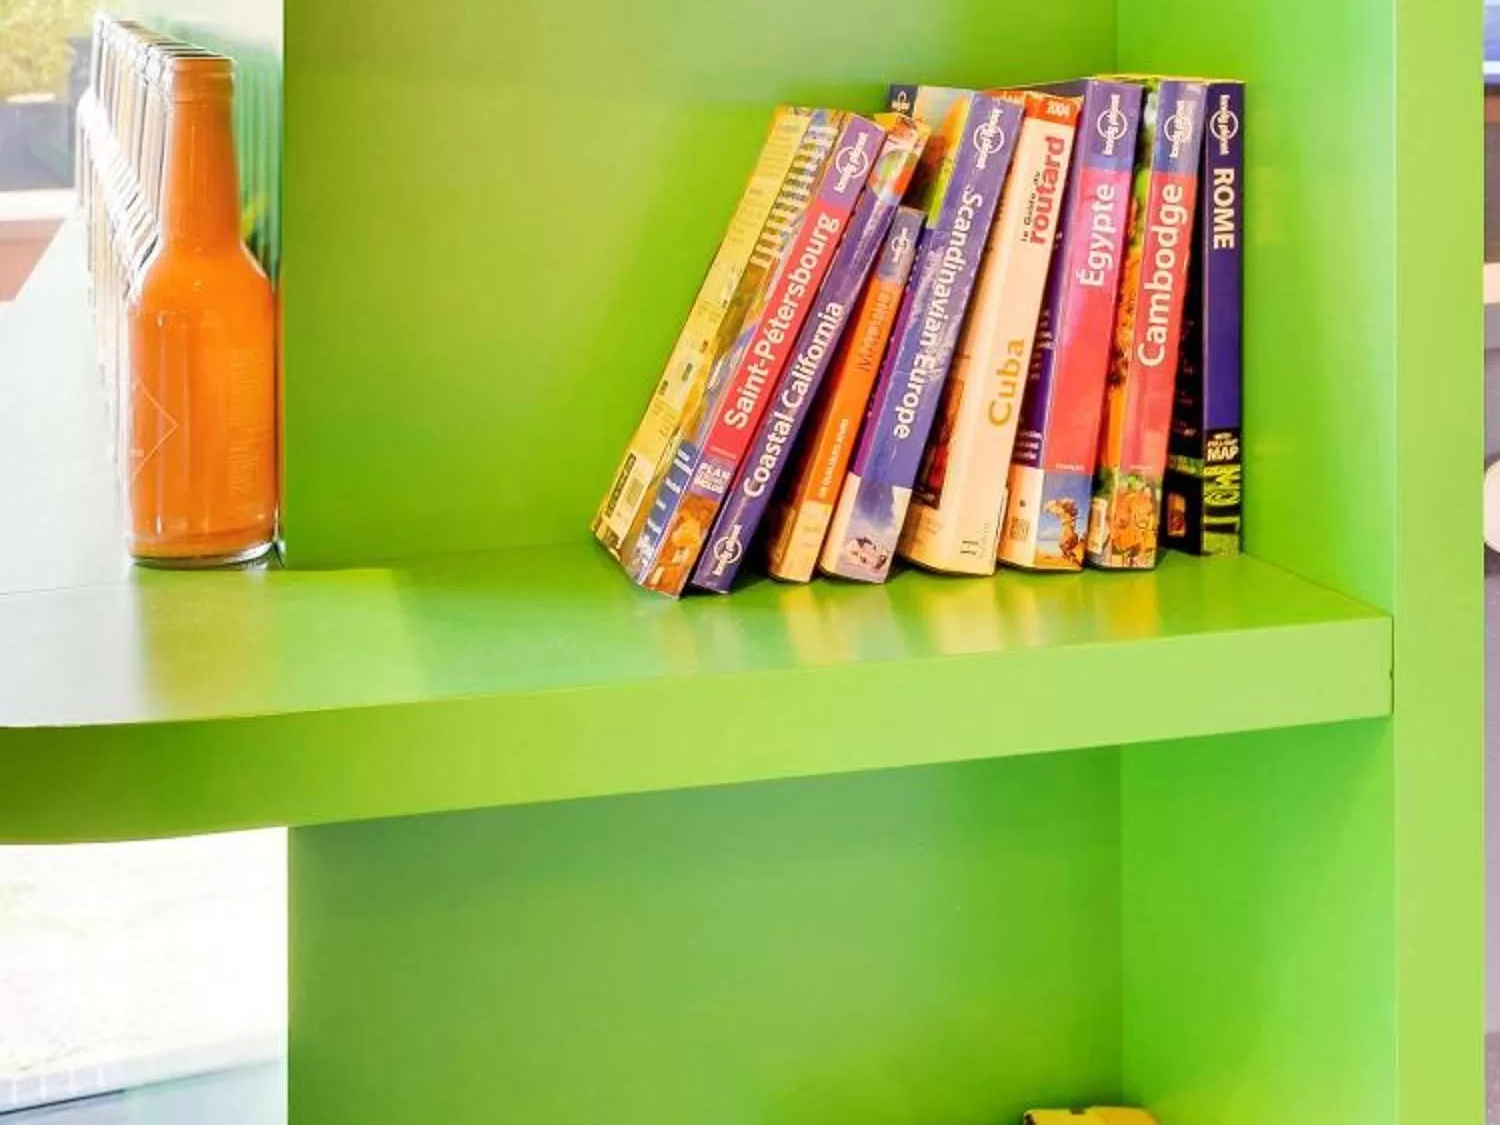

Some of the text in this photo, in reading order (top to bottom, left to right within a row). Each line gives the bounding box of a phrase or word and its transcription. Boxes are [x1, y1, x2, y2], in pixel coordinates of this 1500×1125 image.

[1029, 136, 1065, 245] routard
[1136, 183, 1183, 367] Cambodge
[1213, 167, 1236, 251] ROME
[723, 212, 840, 431] Saint-Pétersbourg
[742, 300, 845, 500] Coastal California
[893, 186, 982, 440] Scandinavian Europe
[986, 338, 1025, 429] Cuba
